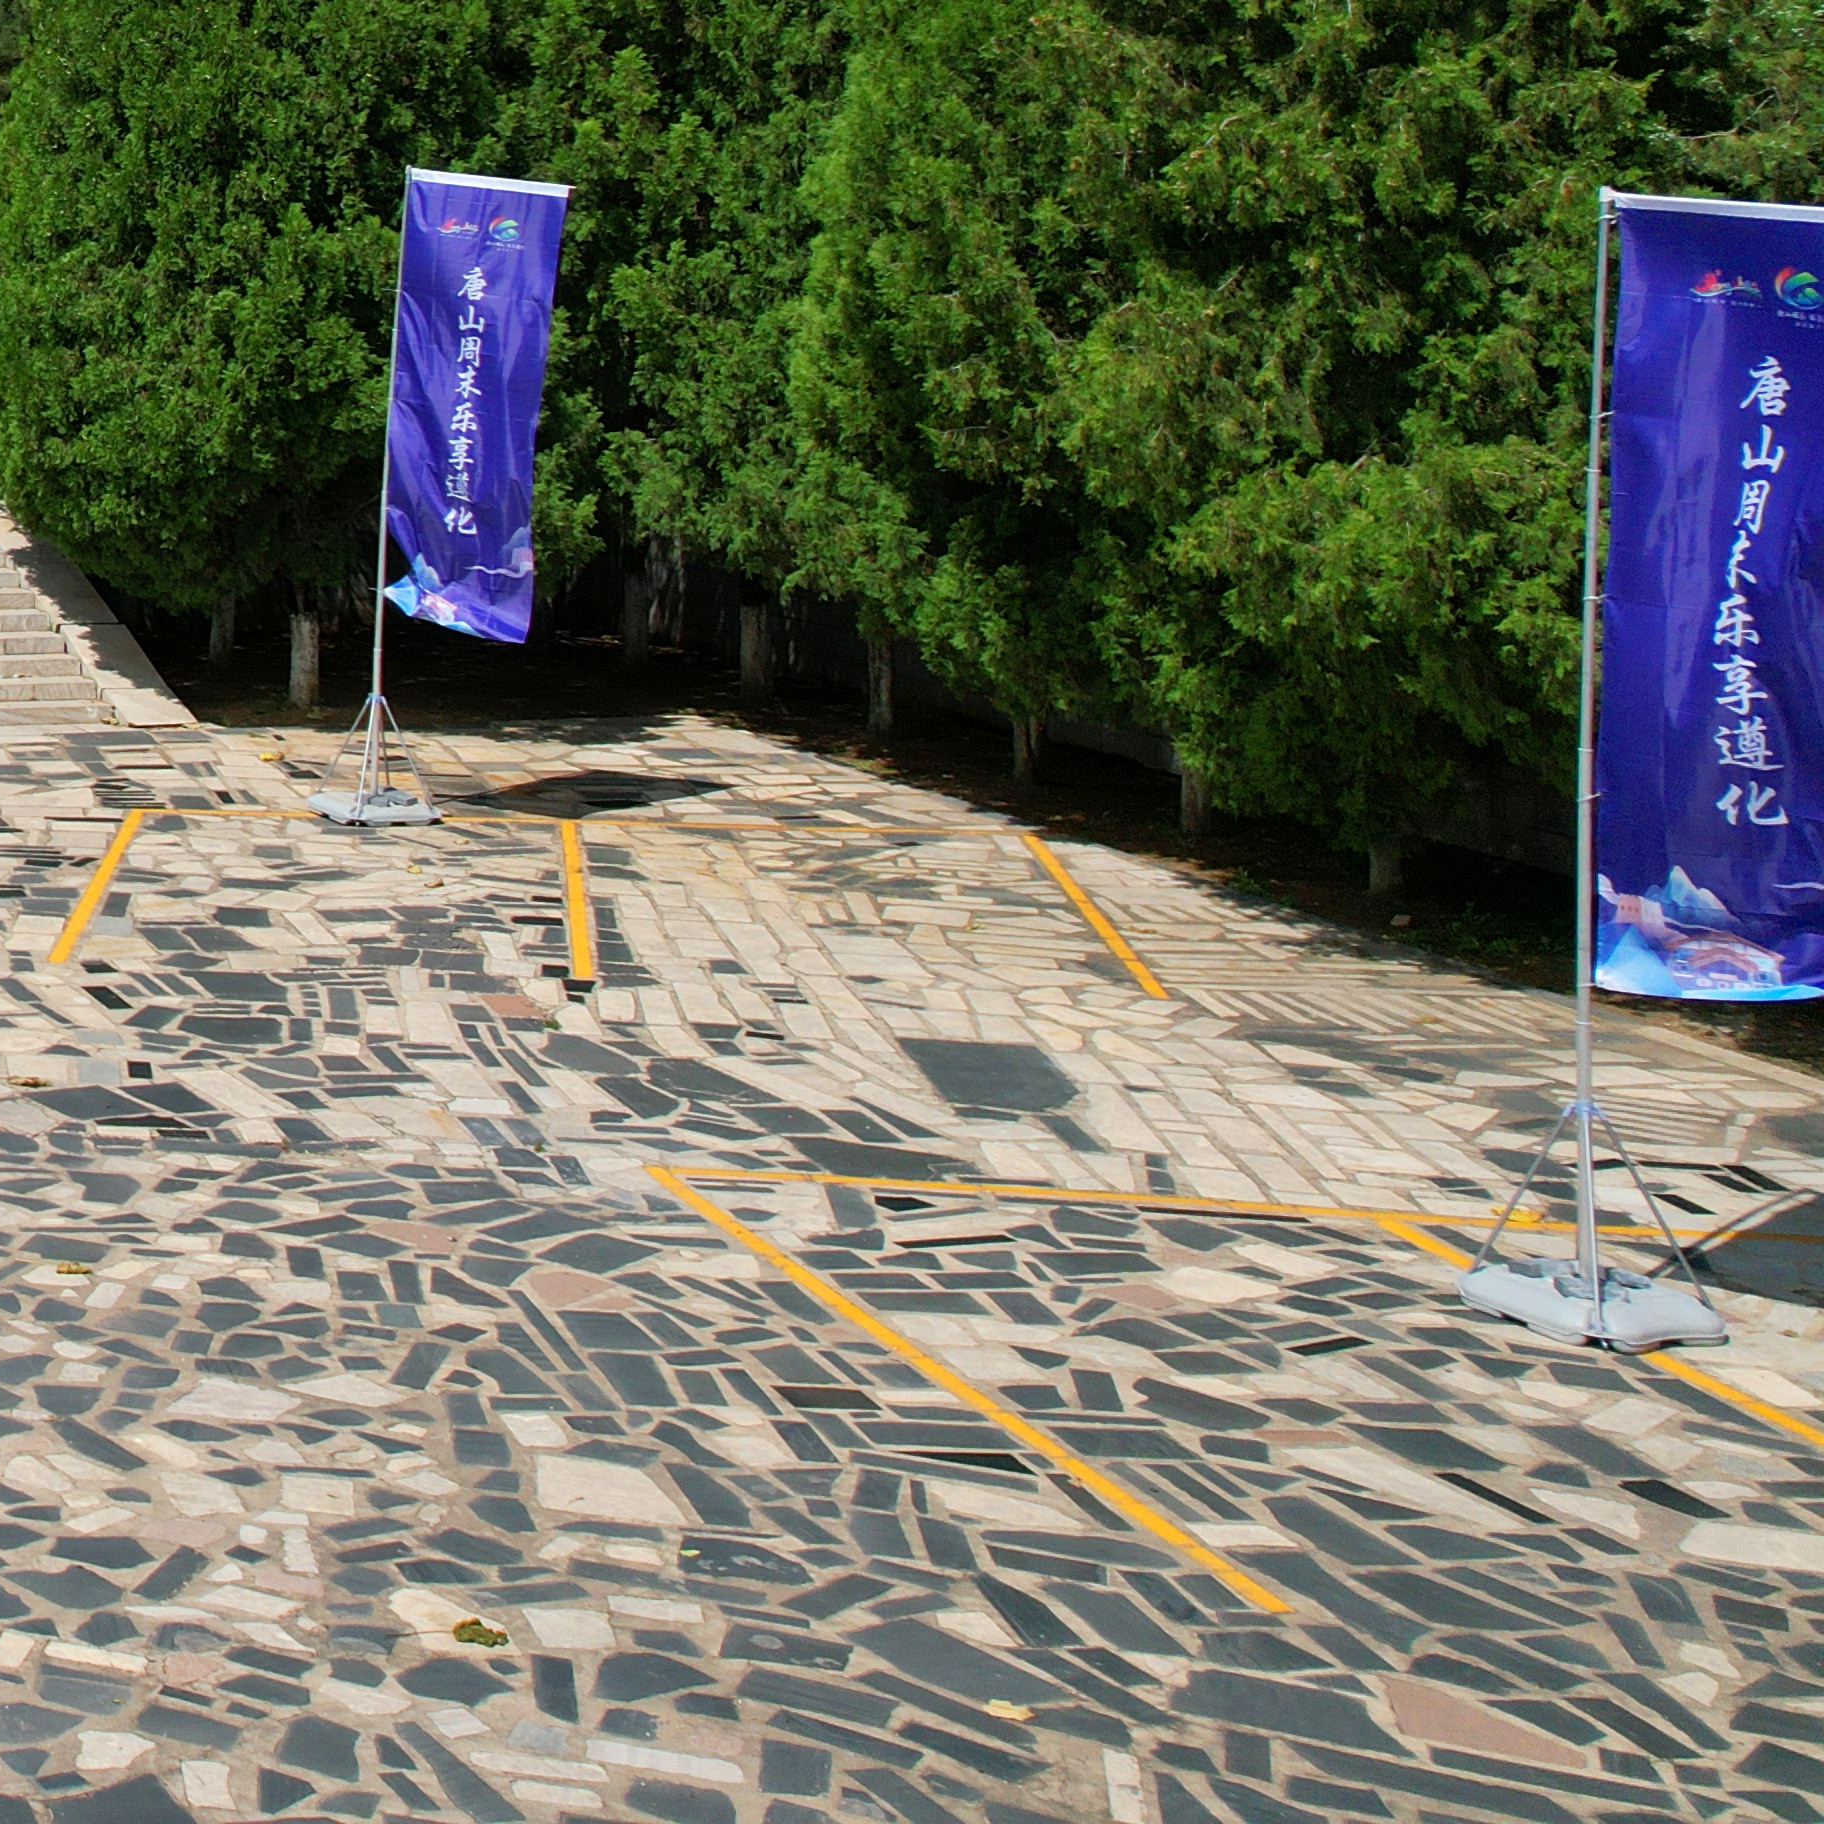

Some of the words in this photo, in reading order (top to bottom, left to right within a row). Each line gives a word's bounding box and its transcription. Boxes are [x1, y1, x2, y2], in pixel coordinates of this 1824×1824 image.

[444, 265, 488, 535] 唐山周末乐享遵化
